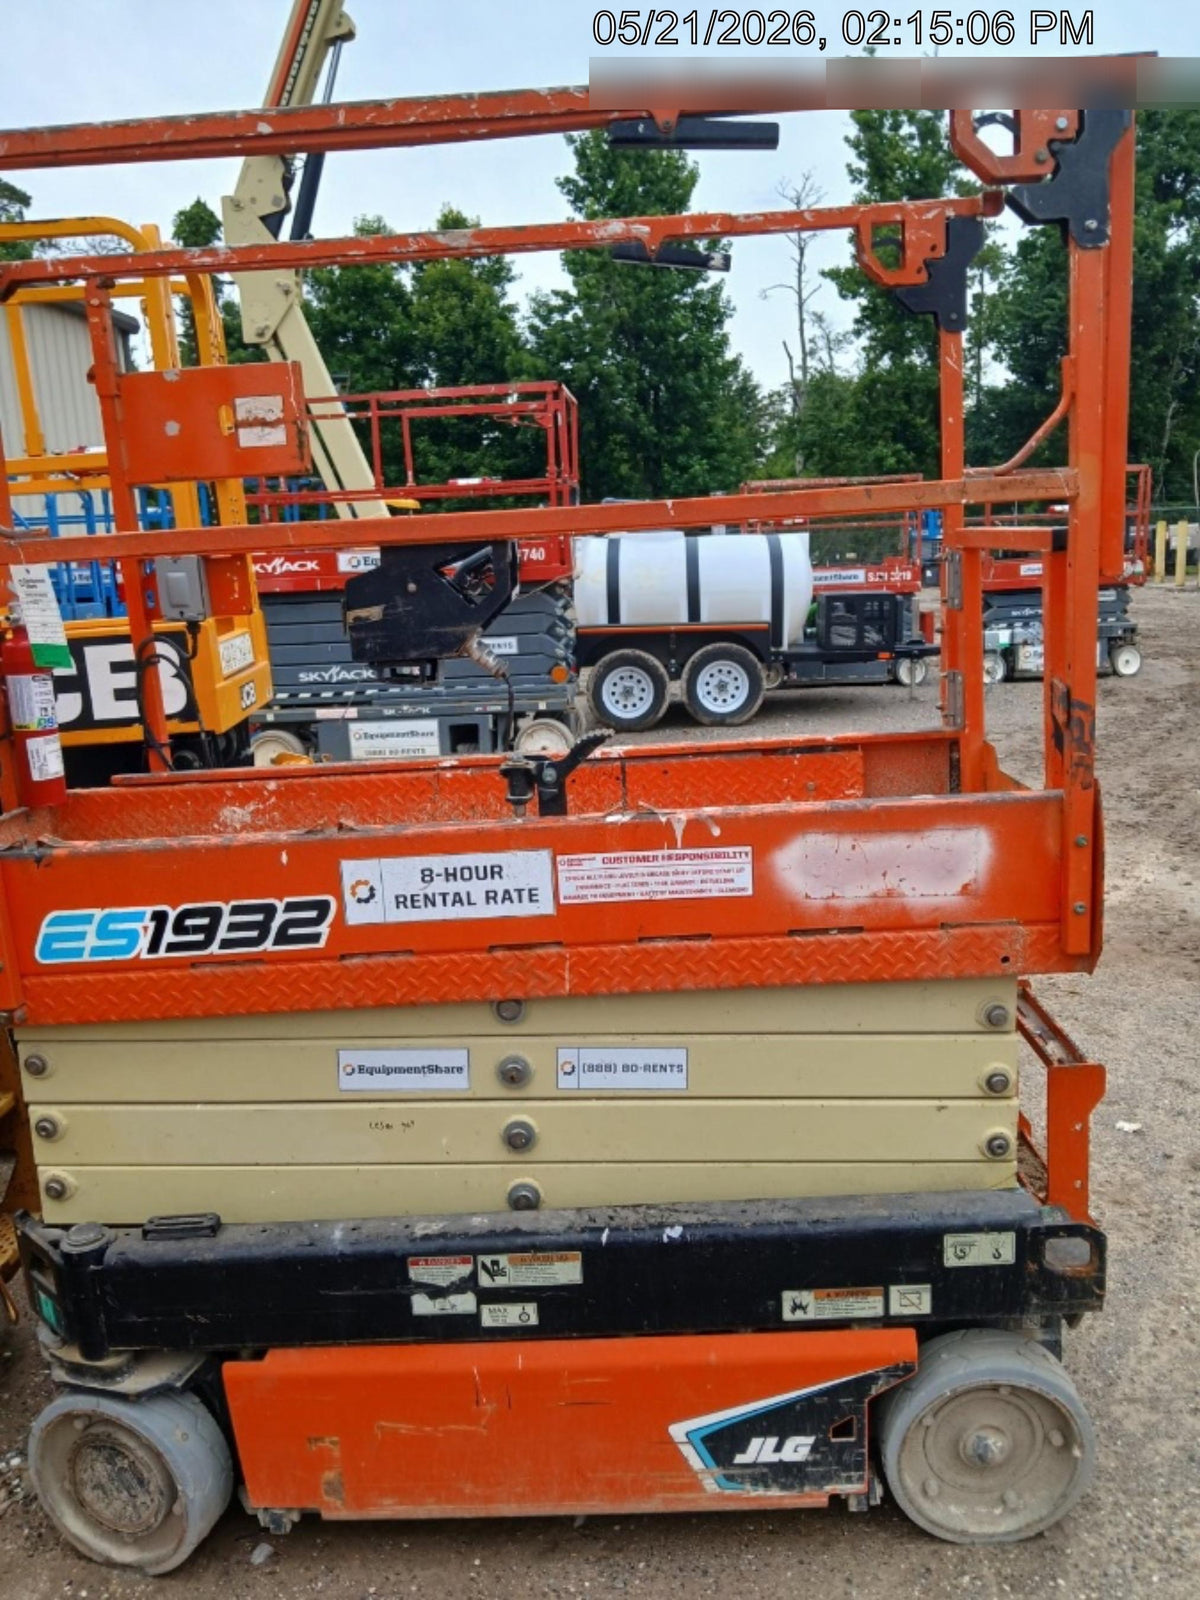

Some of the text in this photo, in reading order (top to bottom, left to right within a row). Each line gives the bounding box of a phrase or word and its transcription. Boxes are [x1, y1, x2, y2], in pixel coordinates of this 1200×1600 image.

[250, 556, 320, 575] KYJACK
[298, 665, 377, 683] SKYJACK
[602, 854, 658, 865] CUSTOMER
[661, 850, 749, 862] RESPONSIBILITY
[420, 864, 504, 884] 8-HOUR
[394, 891, 477, 910] RENTAL
[485, 887, 540, 905] RATE
[36, 895, 336, 964] ES1932
[357, 1064, 464, 1076] EquipmentShare
[582, 1062, 618, 1075] (888)
[733, 1435, 817, 1464] JLG
